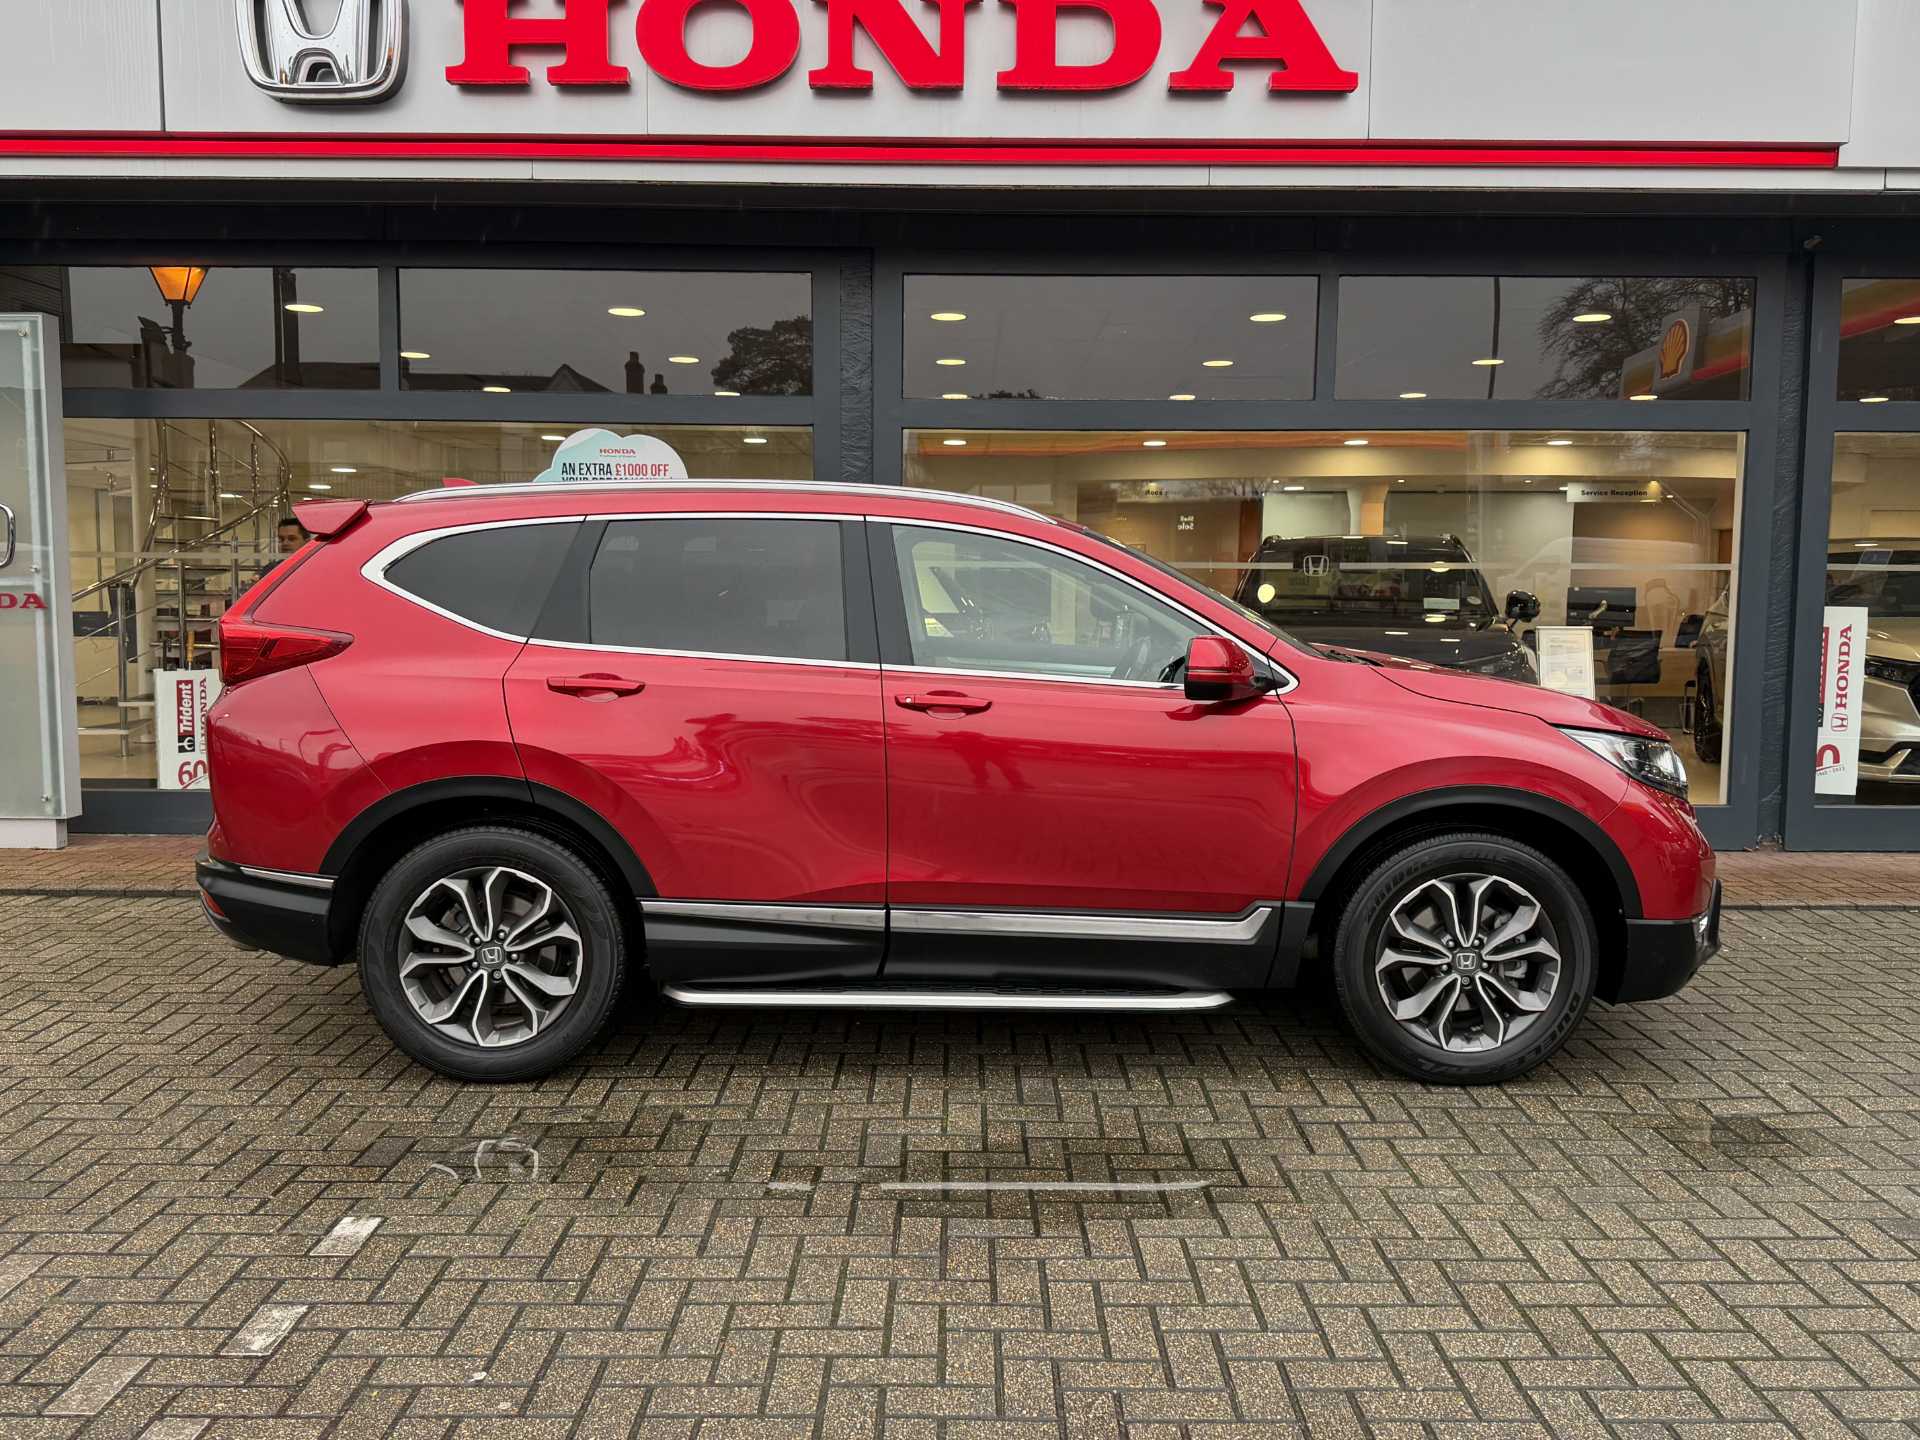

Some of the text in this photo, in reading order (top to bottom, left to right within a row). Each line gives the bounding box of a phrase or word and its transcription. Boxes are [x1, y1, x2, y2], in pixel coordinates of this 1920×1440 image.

[446, 0, 1359, 93] HONDA
[561, 463, 669, 476] AN EXTRA £1000 OFF
[1581, 488, 1648, 497] Service Reception
[1835, 624, 1852, 710] HONDA
[179, 682, 193, 733] Trident
